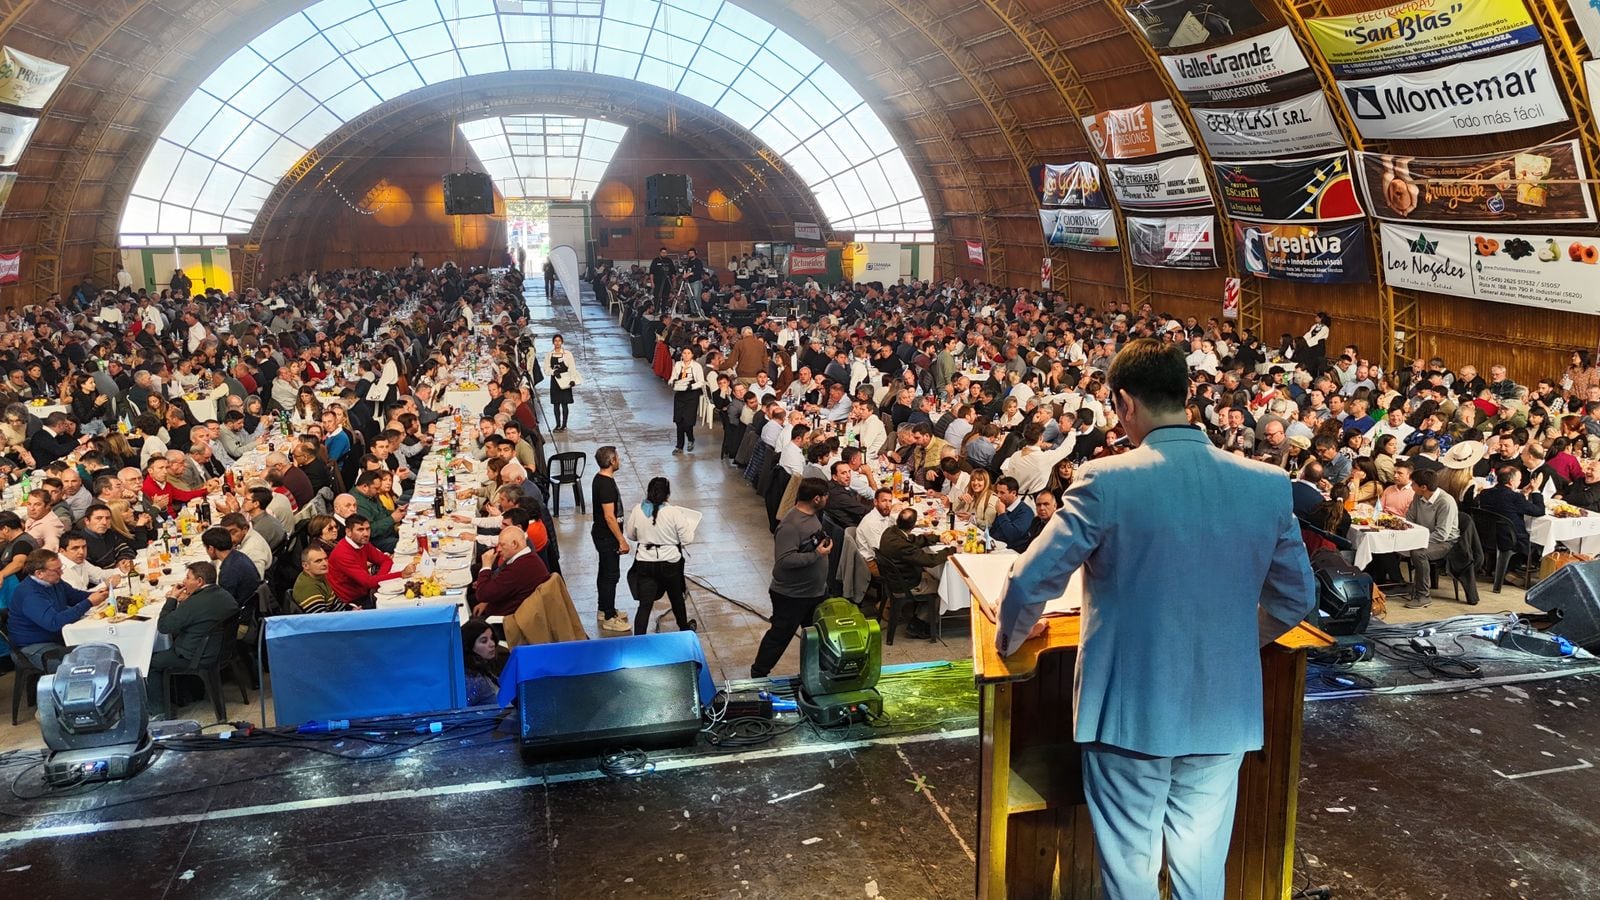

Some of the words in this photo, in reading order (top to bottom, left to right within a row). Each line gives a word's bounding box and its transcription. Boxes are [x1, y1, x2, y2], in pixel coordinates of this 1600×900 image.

[1471, 33, 1512, 48] MENDOZA
[1258, 69, 1285, 80] MENDOZA
[1208, 82, 1271, 101] BRIDGESTONE
[1384, 67, 1537, 115] Montemar
[1284, 108, 1312, 126] S.R.L.
[1450, 112, 1481, 129] Todo
[1483, 109, 1511, 126] más
[1514, 104, 1545, 121] fácil
[1264, 231, 1341, 254] Creativa
[1323, 258, 1343, 266] visual
[1387, 250, 1408, 270] Los
[1412, 255, 1465, 282] Nogales
